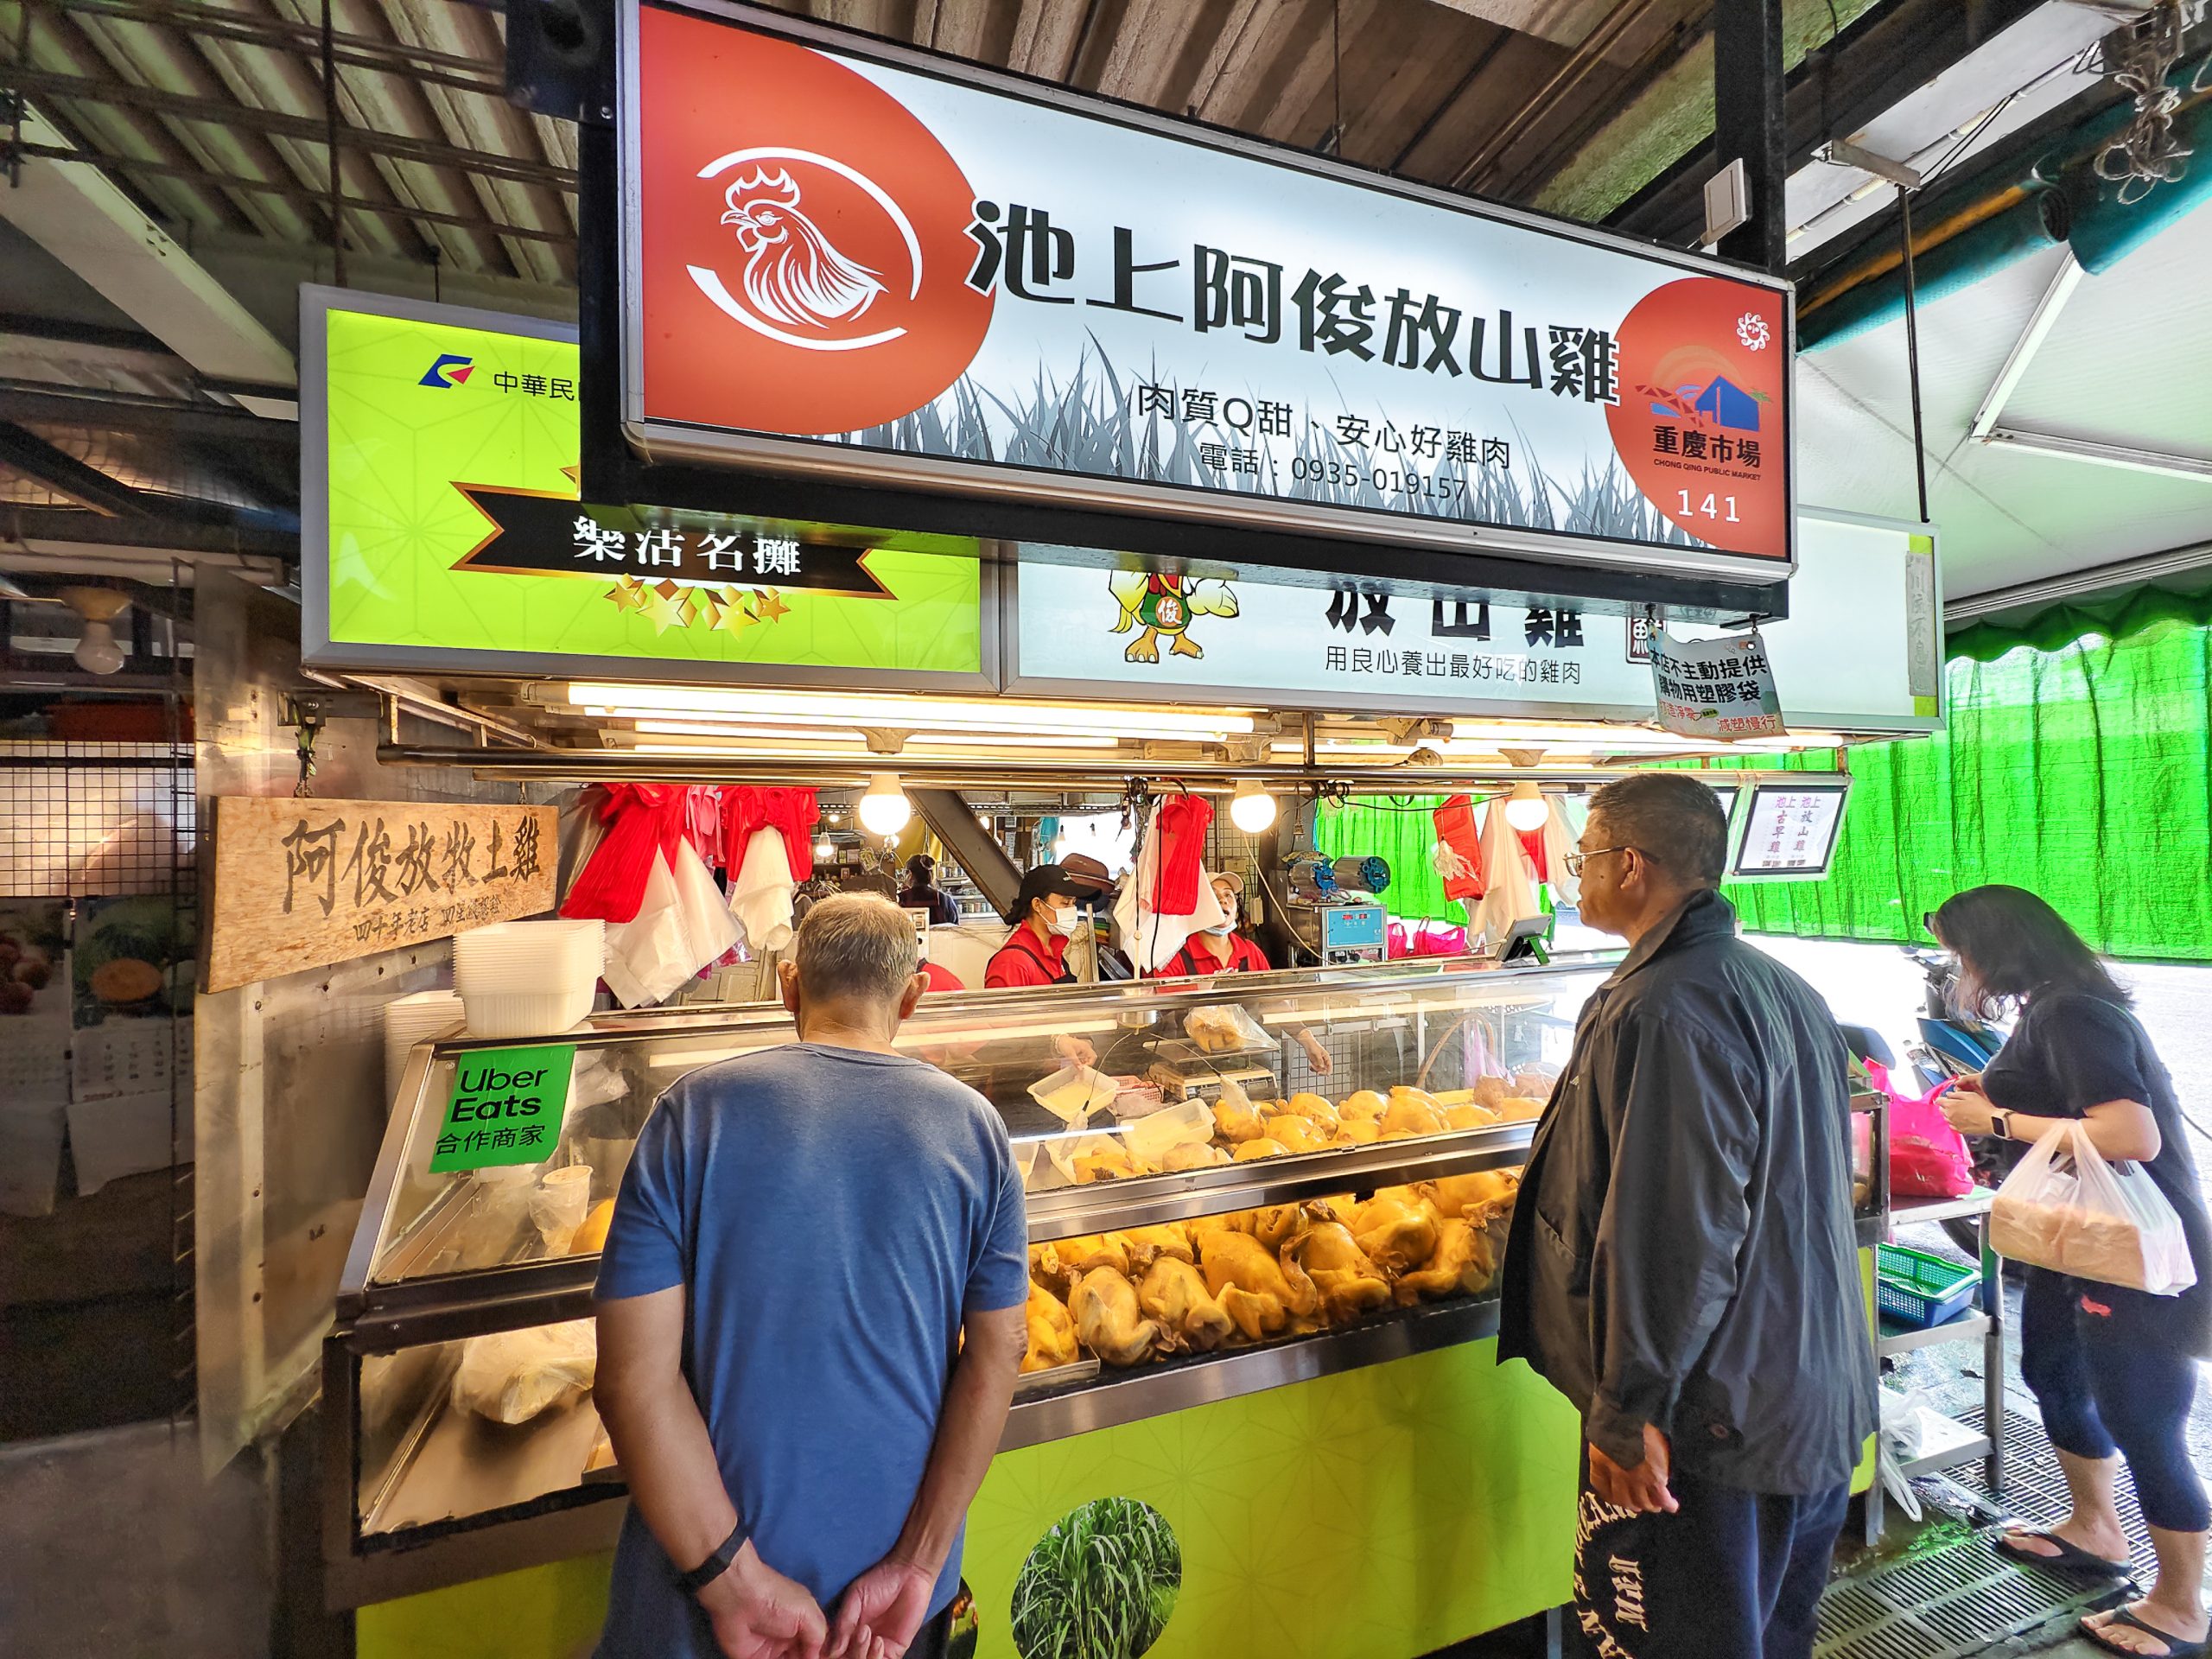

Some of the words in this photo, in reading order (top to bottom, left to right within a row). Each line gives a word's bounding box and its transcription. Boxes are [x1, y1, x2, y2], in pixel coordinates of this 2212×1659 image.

[968, 200, 1618, 404] 池上阿俊放山雞
[493, 371, 580, 401] 中華民
[1138, 384, 1510, 468] 肉質Q甜、安心好雞肉
[1653, 424, 1761, 468] 重慶市場
[1654, 459, 1681, 469] CHONG
[1682, 462, 1703, 473] QING
[1703, 466, 1731, 477] PUBLIC
[1732, 470, 1761, 480] MARKET
[1678, 489, 1740, 523] 141
[1325, 645, 1580, 684] 用良心養出最好吃的雞肉
[1649, 646, 1768, 680] 本店不主動提供
[1659, 674, 1761, 703] 購物用塑膠袋
[282, 816, 540, 917] 阿俊放牧土雞
[460, 1068, 549, 1093] Uber
[450, 1095, 542, 1122] Eats
[436, 1124, 545, 1155] 合作商家
